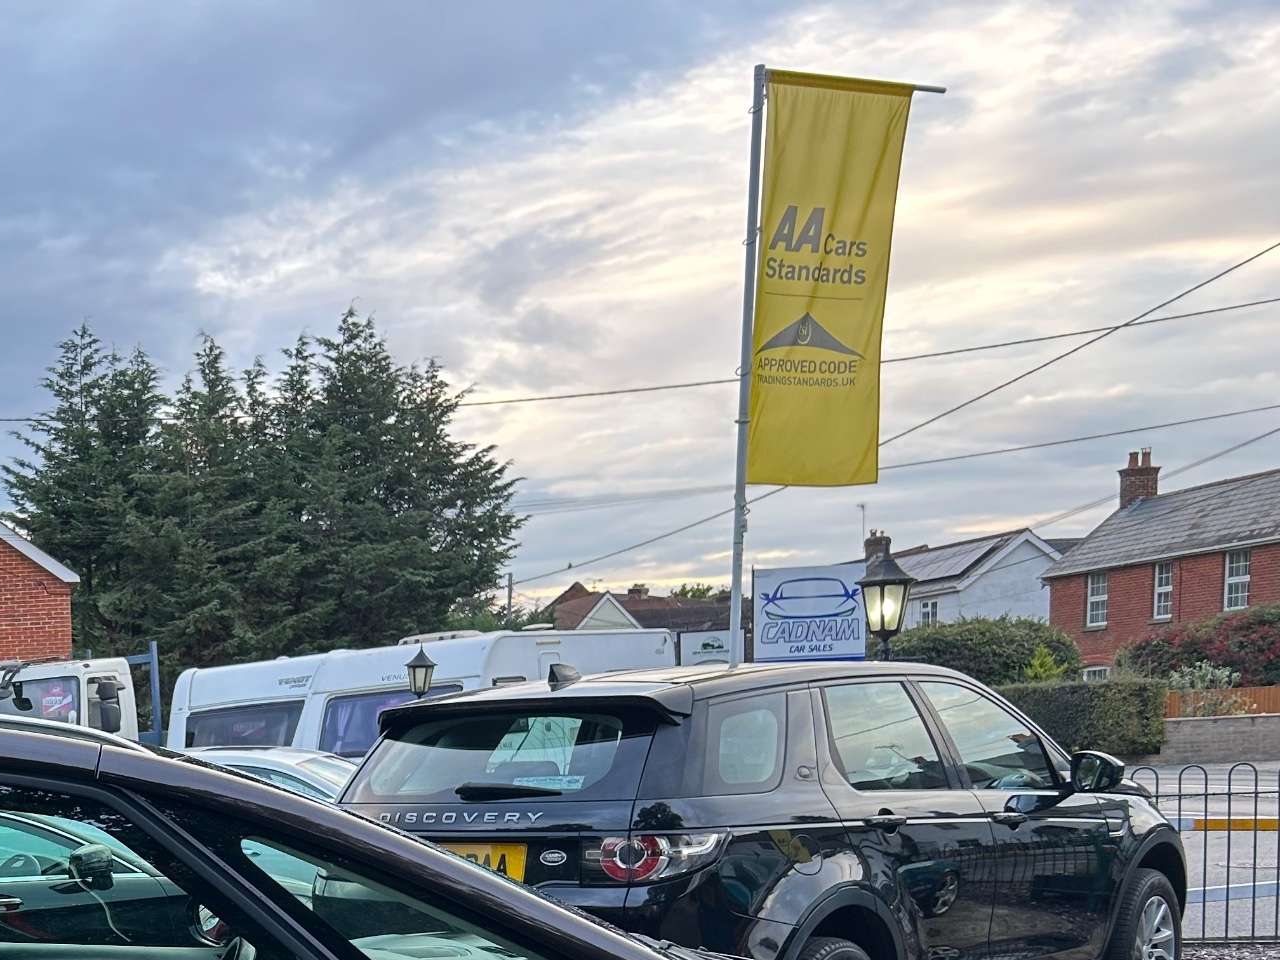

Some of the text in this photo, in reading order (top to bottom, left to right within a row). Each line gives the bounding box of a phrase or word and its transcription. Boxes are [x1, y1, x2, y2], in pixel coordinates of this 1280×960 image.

[768, 205, 868, 257] AA Cars
[765, 257, 867, 285] Standards
[757, 357, 857, 374] APPROVED CODE
[756, 374, 856, 388] TRADINGSTANDARDS.UK
[761, 618, 860, 645] CADNAM
[789, 644, 833, 653] CAR SALES
[379, 812, 543, 824] DISCOVERY
